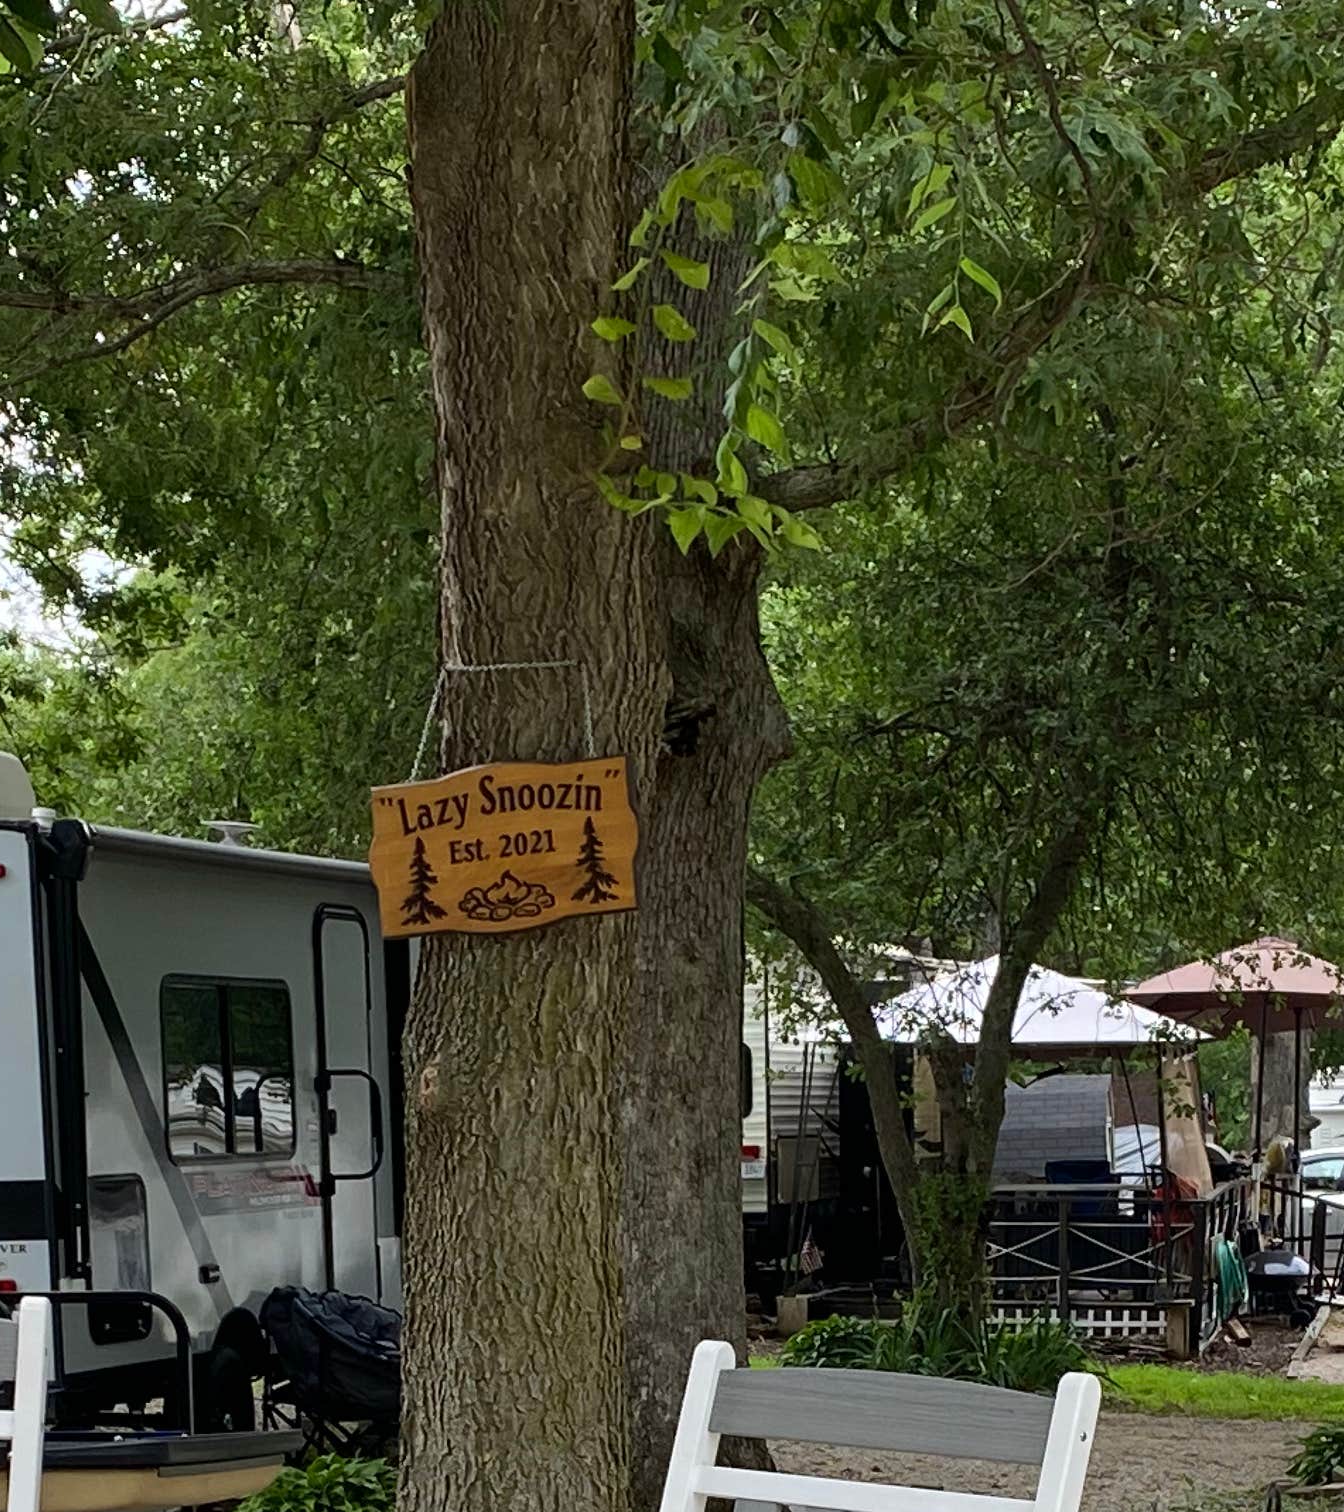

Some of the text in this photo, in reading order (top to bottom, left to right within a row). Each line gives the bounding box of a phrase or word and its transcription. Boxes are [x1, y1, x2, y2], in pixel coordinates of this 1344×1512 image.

[379, 769, 620, 836] "Lazy Snoozin"
[449, 828, 556, 865] Est. 2021
